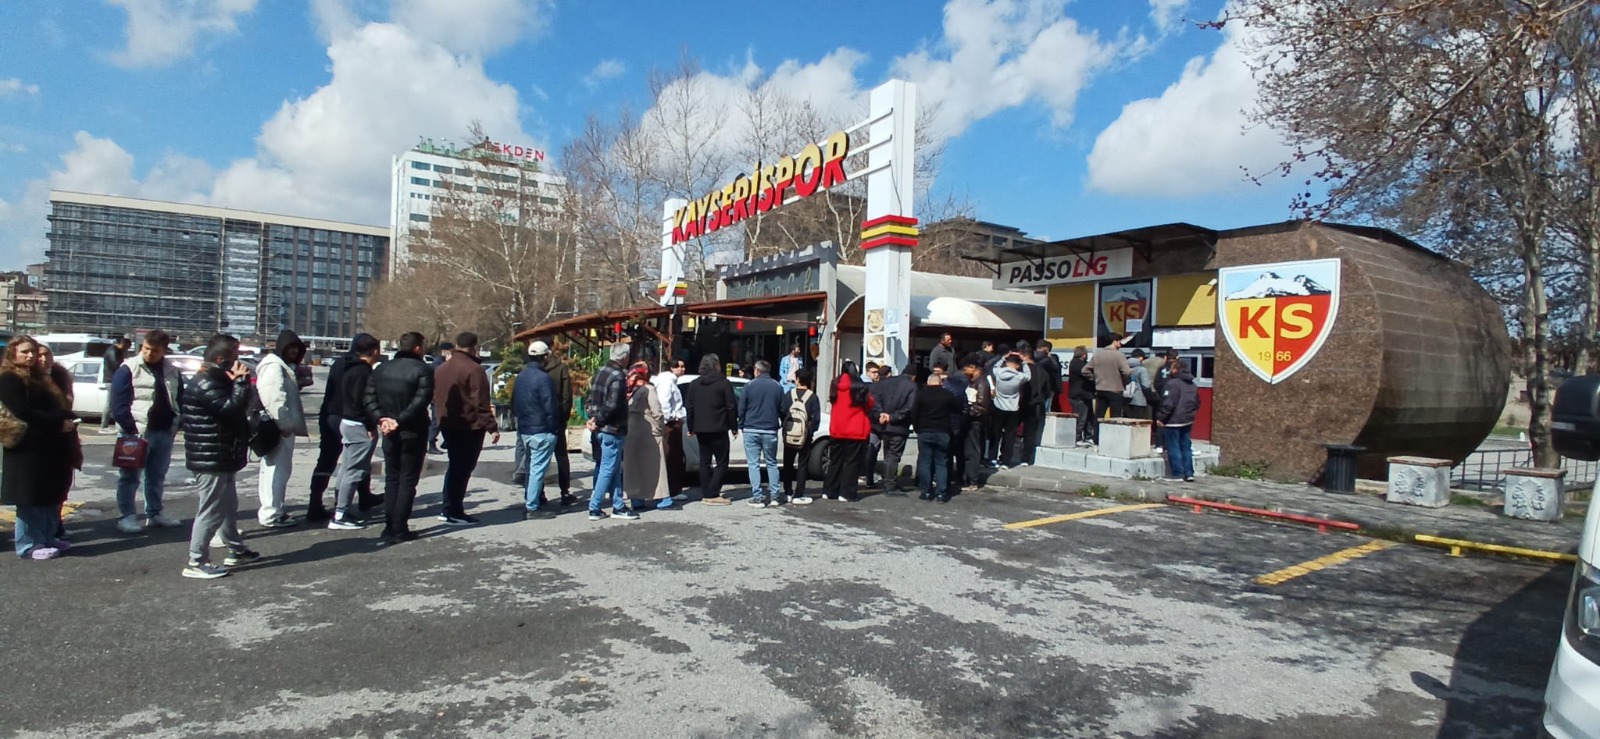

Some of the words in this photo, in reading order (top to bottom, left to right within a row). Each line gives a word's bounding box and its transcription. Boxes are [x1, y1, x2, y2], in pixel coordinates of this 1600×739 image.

[672, 130, 849, 246] KAYSERİSPOR
[1009, 256, 1108, 284] PASSOLIG
[1239, 302, 1314, 340] KS
